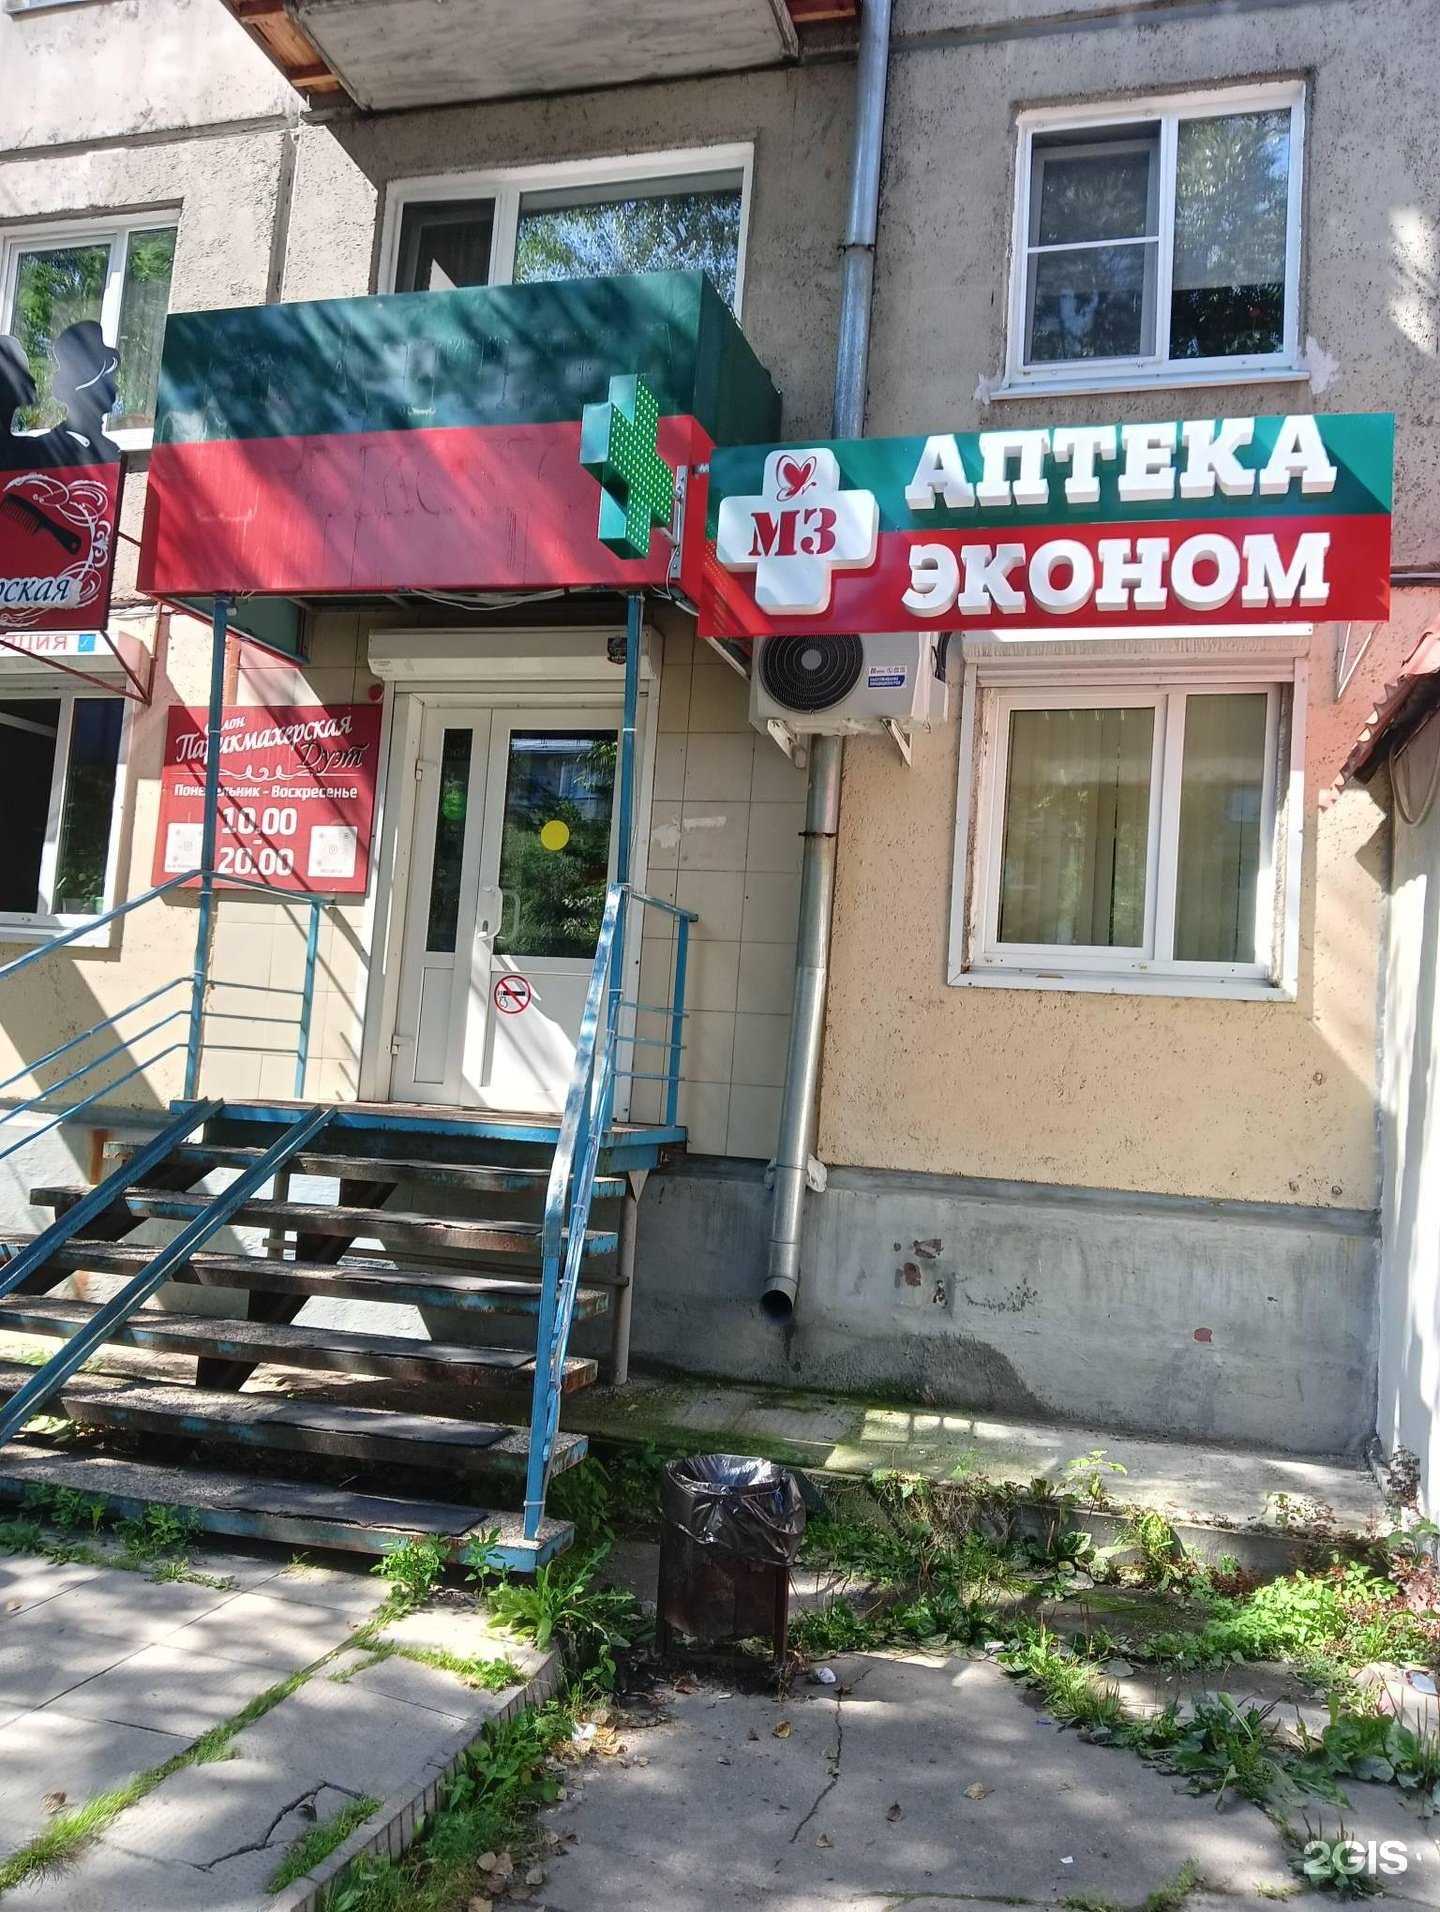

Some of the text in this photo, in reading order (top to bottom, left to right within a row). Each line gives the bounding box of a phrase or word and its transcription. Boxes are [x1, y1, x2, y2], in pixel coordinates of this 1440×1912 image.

[905, 414, 1338, 510] АПТЕКА
[902, 532, 1331, 618] ЭКОНОМ
[271, 785, 358, 801] Воскресенье
[221, 807, 298, 836] 10.00
[217, 847, 294, 876] 20.00
